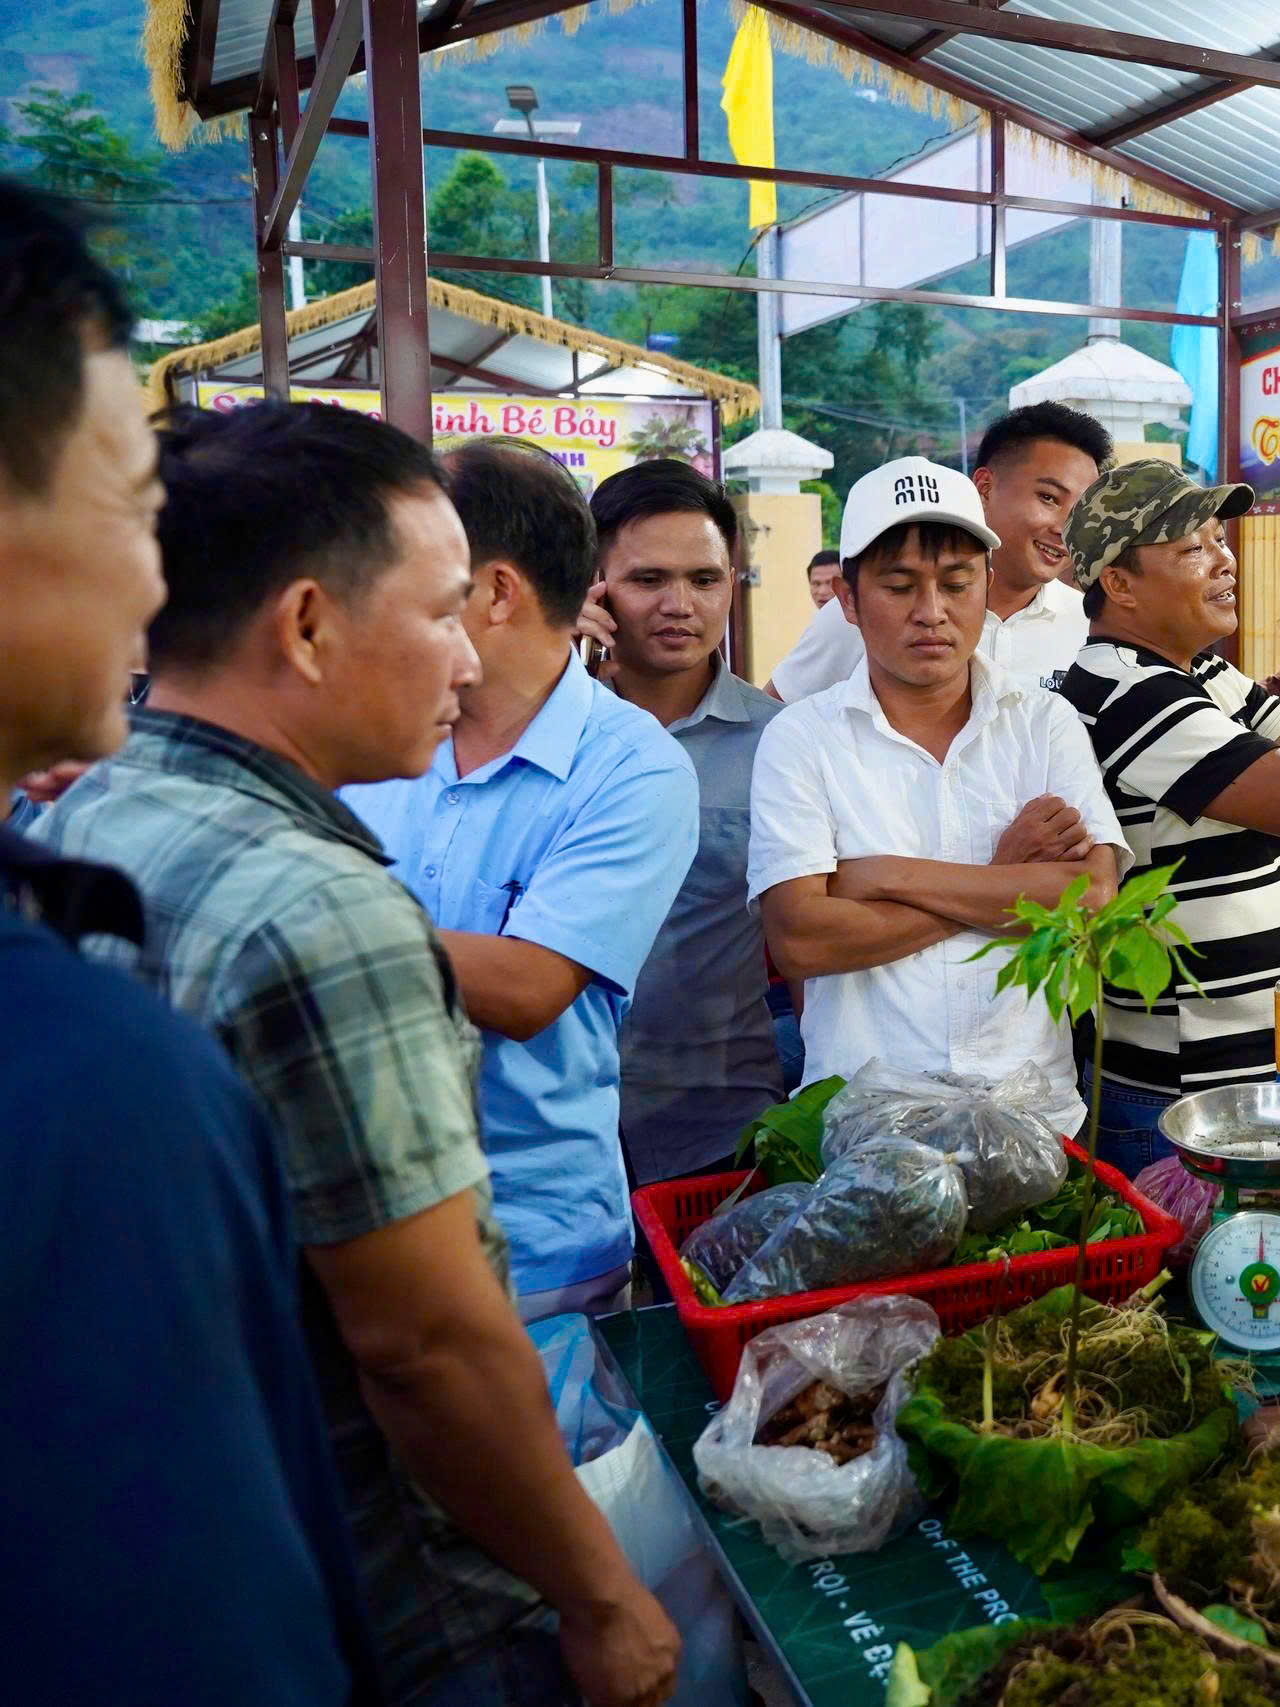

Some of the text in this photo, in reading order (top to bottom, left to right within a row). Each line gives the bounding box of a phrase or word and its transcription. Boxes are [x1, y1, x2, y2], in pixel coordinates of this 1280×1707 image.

[435, 402, 617, 447] inh Bé Bảy
[945, 1551, 988, 1589] THE
